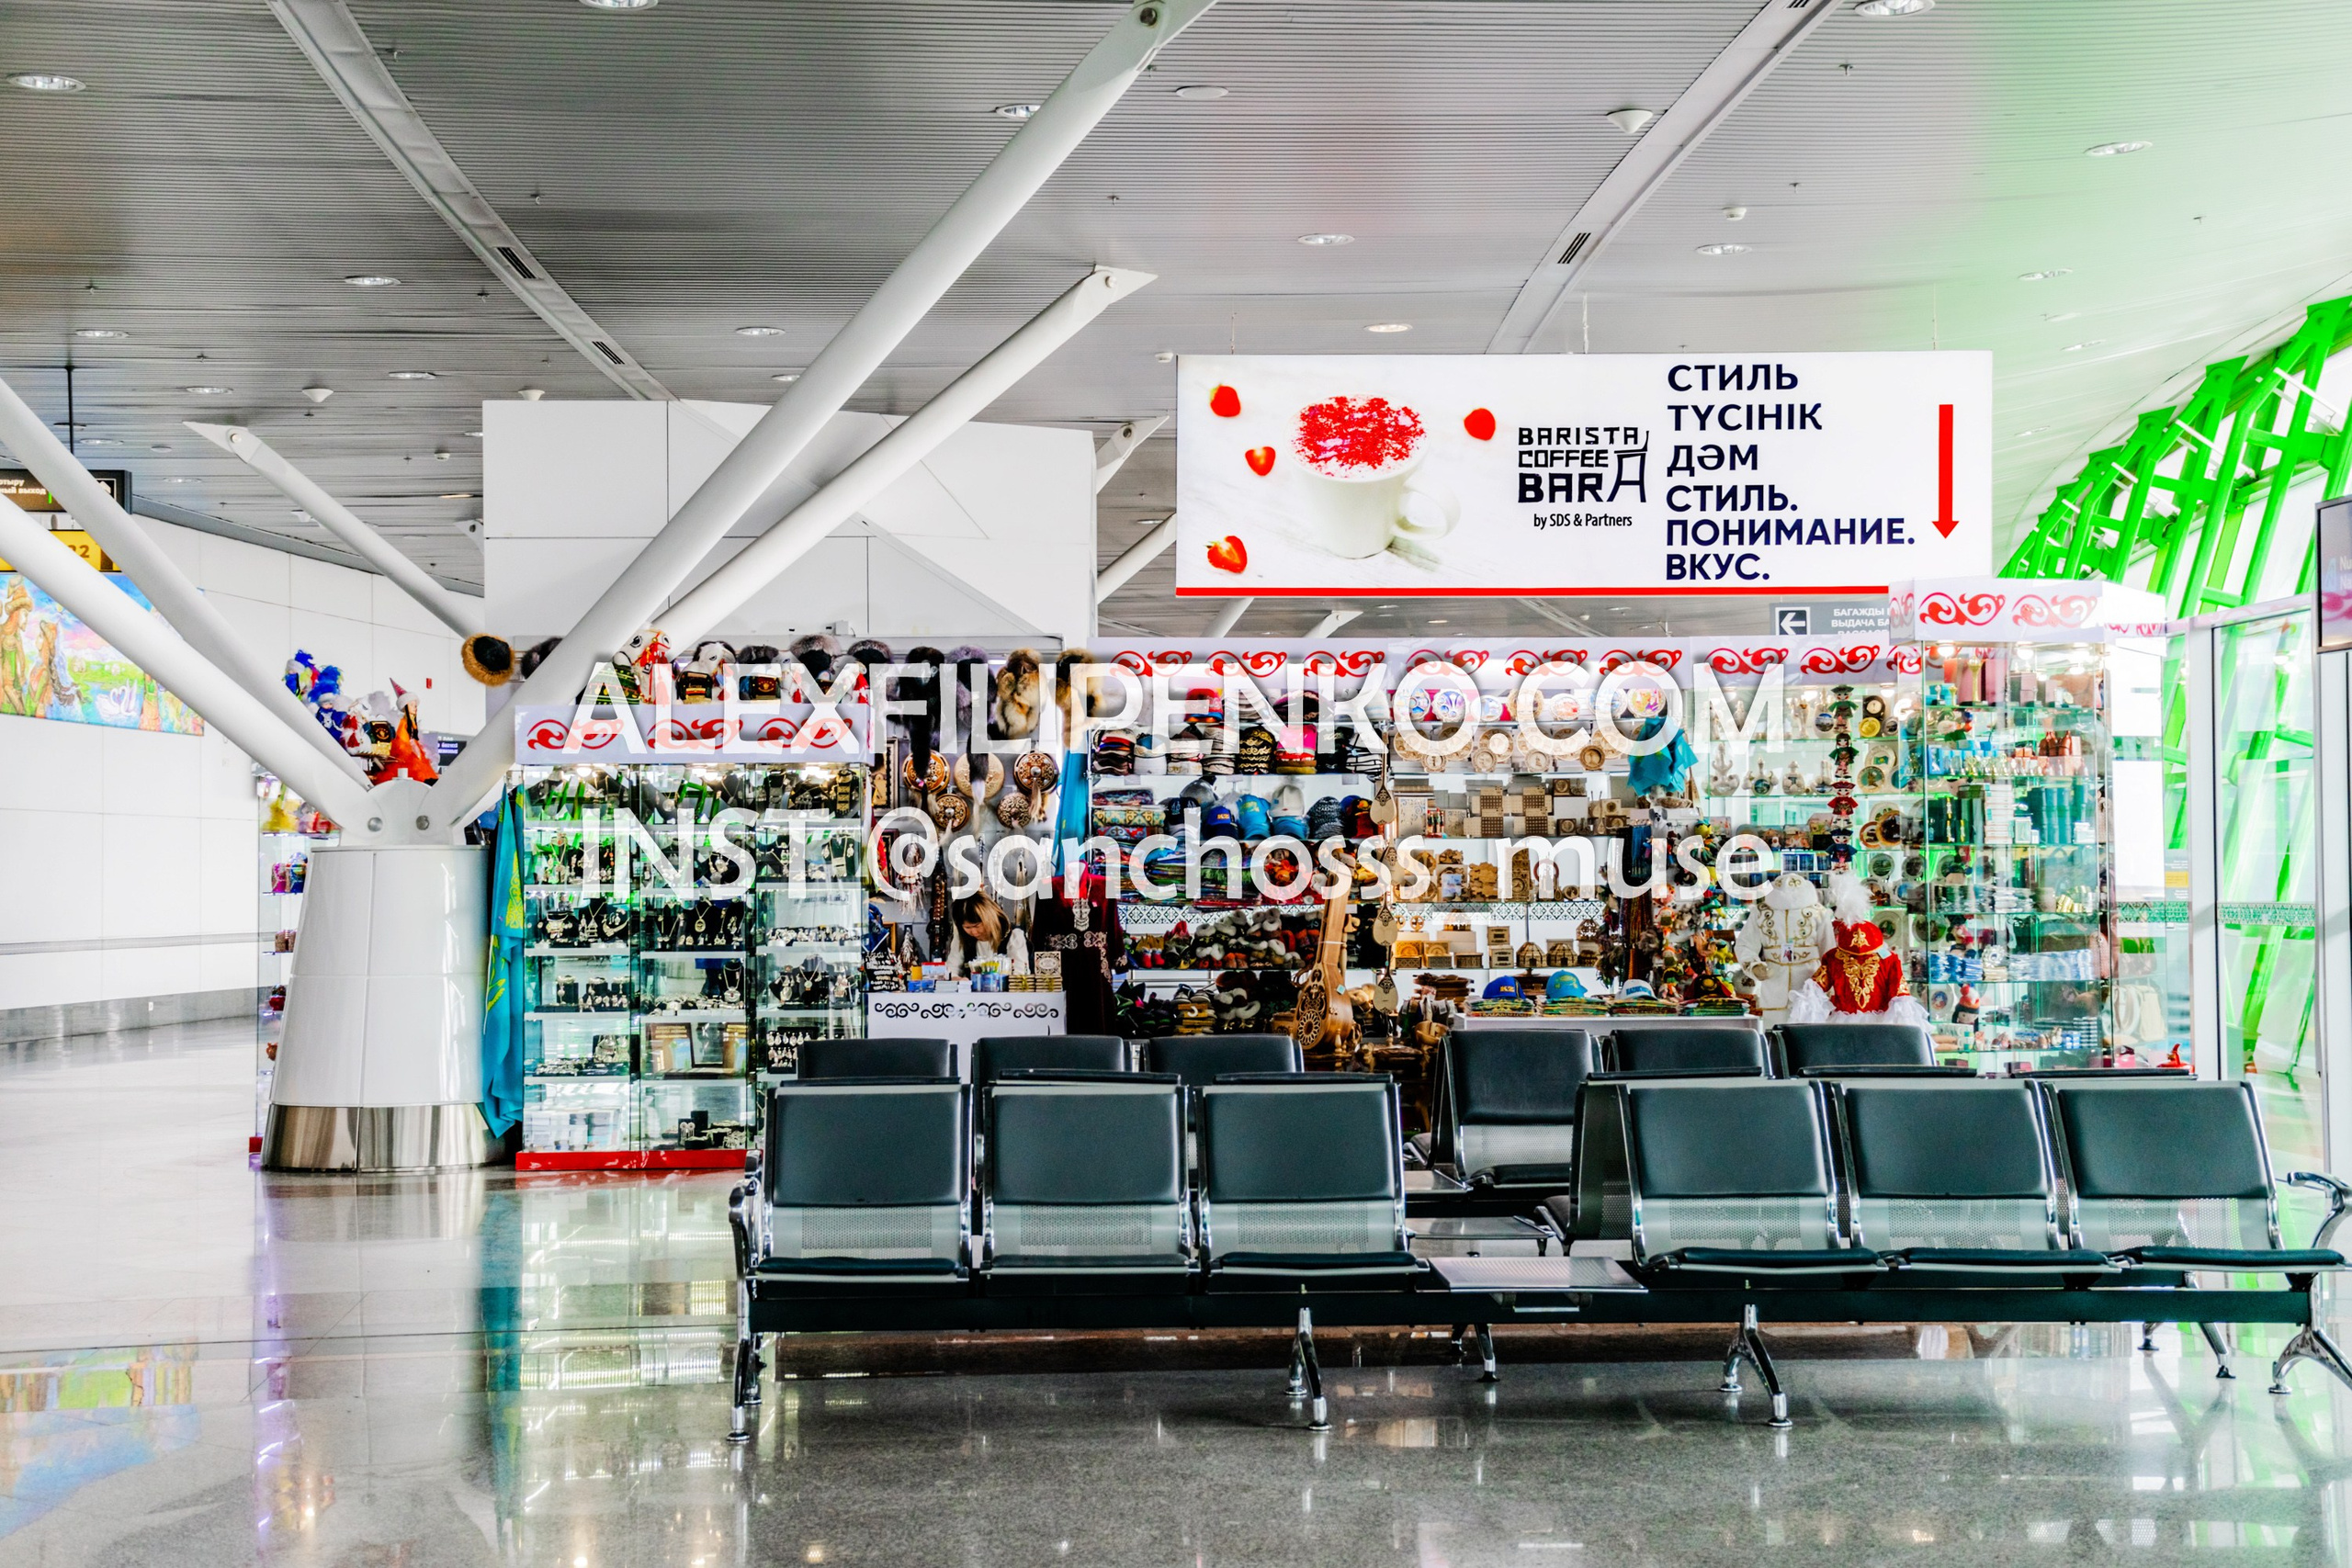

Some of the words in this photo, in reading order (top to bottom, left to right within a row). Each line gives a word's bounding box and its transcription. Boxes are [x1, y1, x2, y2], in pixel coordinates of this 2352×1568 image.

[1668, 364, 1798, 391] СТИЛЬ
[1667, 402, 1822, 431] ТҮСІНІК
[1518, 427, 1638, 446] BARISTA
[1518, 449, 1609, 468] COFFEE
[1667, 444, 1758, 477] ДӘМ
[1666, 484, 1798, 512] СТИЛЬ.
[1533, 513, 1547, 530] by
[1549, 513, 1570, 526] SDS
[1573, 513, 1582, 526] &
[1585, 513, 1633, 526] Partners
[1667, 517, 1915, 547] ПОНИМАНИЕ.
[1666, 553, 1770, 580] ВКУС.
[1831, 618, 1875, 628] ВЫДАЧА
[1833, 607, 1884, 617] БАГАЖДЫ
